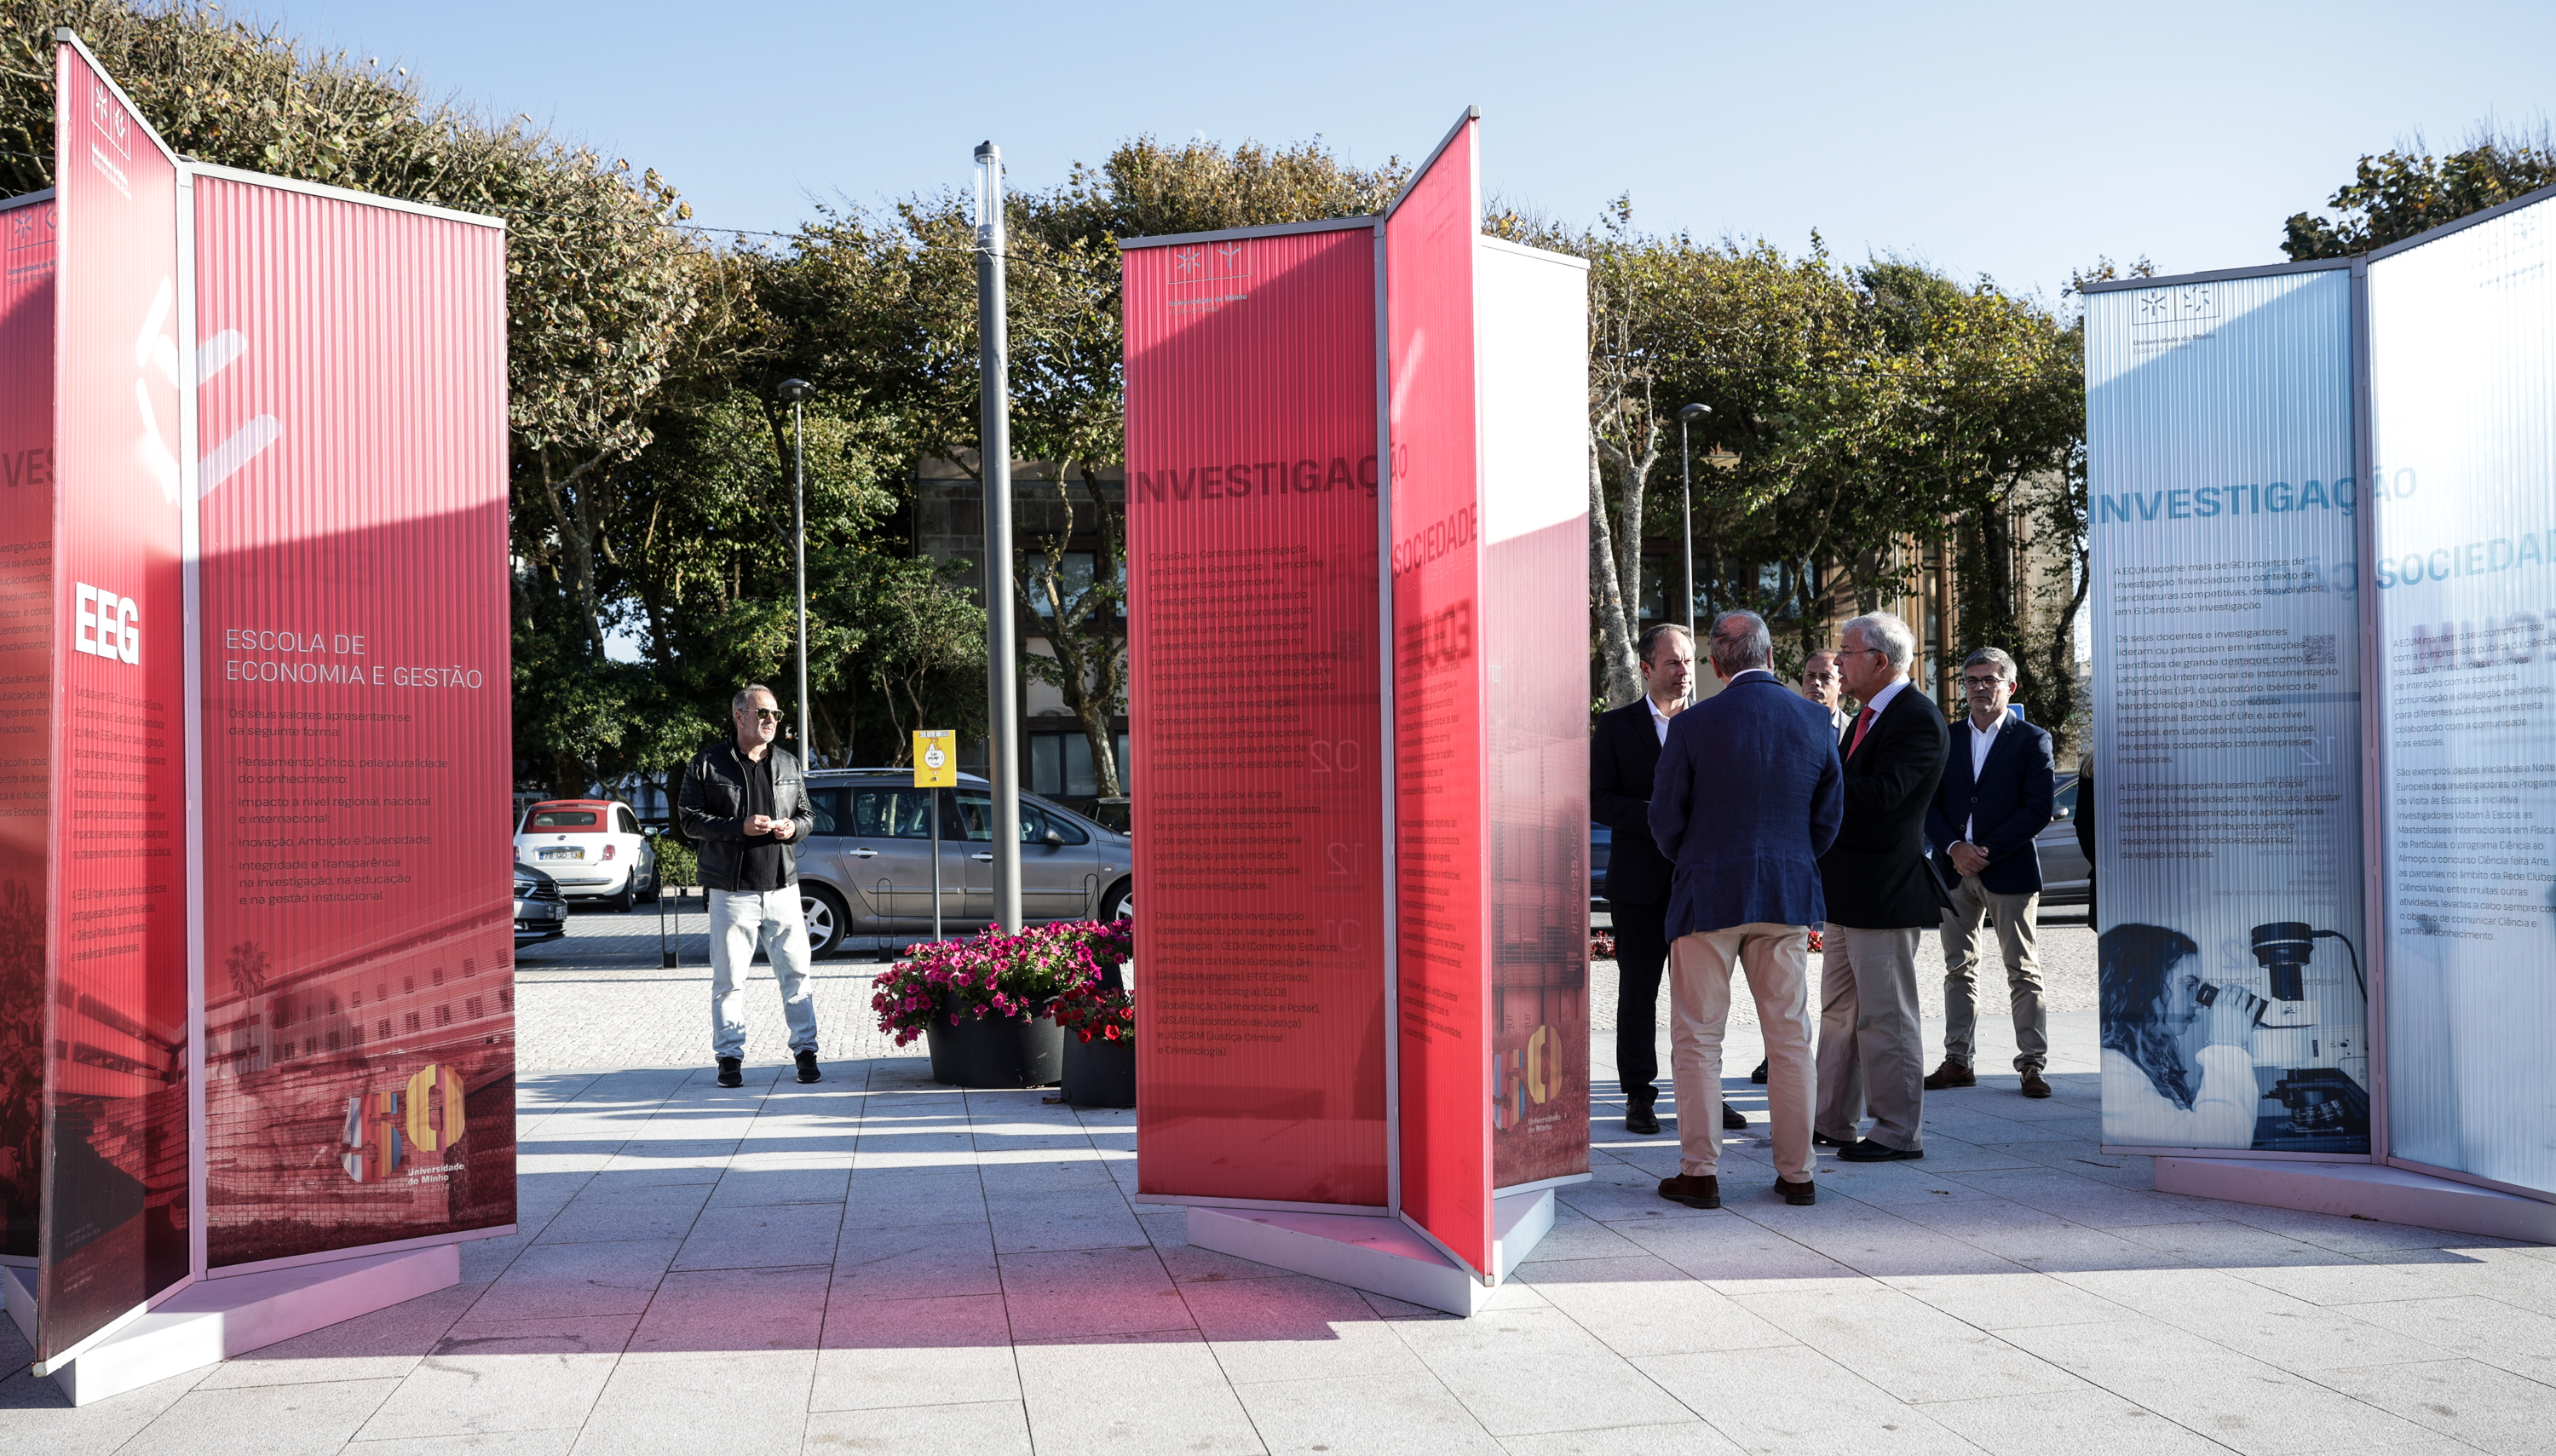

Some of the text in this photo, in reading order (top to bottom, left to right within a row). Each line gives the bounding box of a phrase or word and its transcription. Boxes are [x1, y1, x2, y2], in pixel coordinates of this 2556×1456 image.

[1169, 297, 1213, 307] Universidade
[2133, 335, 2180, 346] Universidade
[2192, 332, 2216, 341] Minho
[2165, 342, 2191, 352] Ciências
[1394, 500, 1477, 579] SOCIEDADE
[2114, 555, 2305, 575] A ECUM acolhe mais de 90 projetos de
[2115, 576, 2175, 591] investigação
[2178, 573, 2235, 585] financiados
[2253, 570, 2298, 582] contexto
[2300, 569, 2314, 579] de
[2115, 590, 2179, 602] candidaturas
[2249, 583, 2323, 596] desenvolvidos
[2134, 605, 2141, 615] 6
[2143, 603, 2181, 614] Centros
[2184, 602, 2196, 613] de
[75, 581, 140, 665] EEG
[227, 629, 365, 654] ESCOLA DE
[227, 660, 482, 688] ECONOMIA E GESTÃO
[2394, 681, 2404, 690] de
[2406, 677, 2443, 692] interação
[2444, 678, 2463, 687] com
[228, 708, 245, 718] Os
[248, 711, 277, 719] seus
[279, 709, 322, 720] valores
[228, 725, 245, 735] da
[247, 725, 300, 739] seguinte
[238, 756, 314, 767] Pensamento
[360, 757, 383, 770] pela
[387, 757, 448, 770] pluralidade
[2397, 767, 2410, 776] São
[2413, 766, 2451, 778] exemplos
[2453, 765, 2480, 774] destas
[2482, 763, 2524, 774] iniciativas
[2532, 763, 2555, 772] Noite
[238, 773, 255, 784] do
[238, 796, 289, 809] Impacto
[292, 798, 300, 807] a
[302, 796, 330, 806] nível
[383, 796, 430, 806] nacional
[239, 815, 246, 824] e
[297, 835, 351, 849] Ambição
[354, 837, 361, 846] e
[239, 856, 401, 872] Integridade e Transparência
[2478, 855, 2508, 865] Ciência
[2510, 856, 2529, 866] feita
[239, 879, 255, 888] na
[337, 877, 351, 885] na
[354, 872, 411, 888] educação
[1569, 811, 1580, 935] #EDUM25ANOS
[239, 897, 247, 906] e
[250, 896, 266, 905] na
[268, 892, 309, 906] gestão
[1155, 912, 1162, 920] O
[1183, 913, 1229, 923] programa
[1230, 912, 1243, 920] de
[1246, 912, 1304, 923] investigação
[2407, 911, 2438, 924] objetivo
[2439, 912, 2450, 922] de
[2452, 913, 2496, 924] comunicar
[2498, 916, 2530, 926] Ciência
[2400, 925, 2432, 938] partilhar
[1157, 987, 1197, 998] Empresa
[1264, 987, 1287, 997] GLOB
[1220, 1002, 1276, 1011] Democracia
[1157, 1016, 1301, 1029] JUSLAB (Laboratório de Justiça)
[1166, 1030, 1205, 1040] JUSCRIM
[1206, 1032, 1242, 1044] (Justiça
[1244, 1033, 1283, 1043] Criminal
[1528, 1114, 1561, 1125] Universidade
[1536, 1124, 1552, 1132] Minho
[408, 1163, 464, 1176] Universidade
[421, 1175, 449, 1184] Minho
